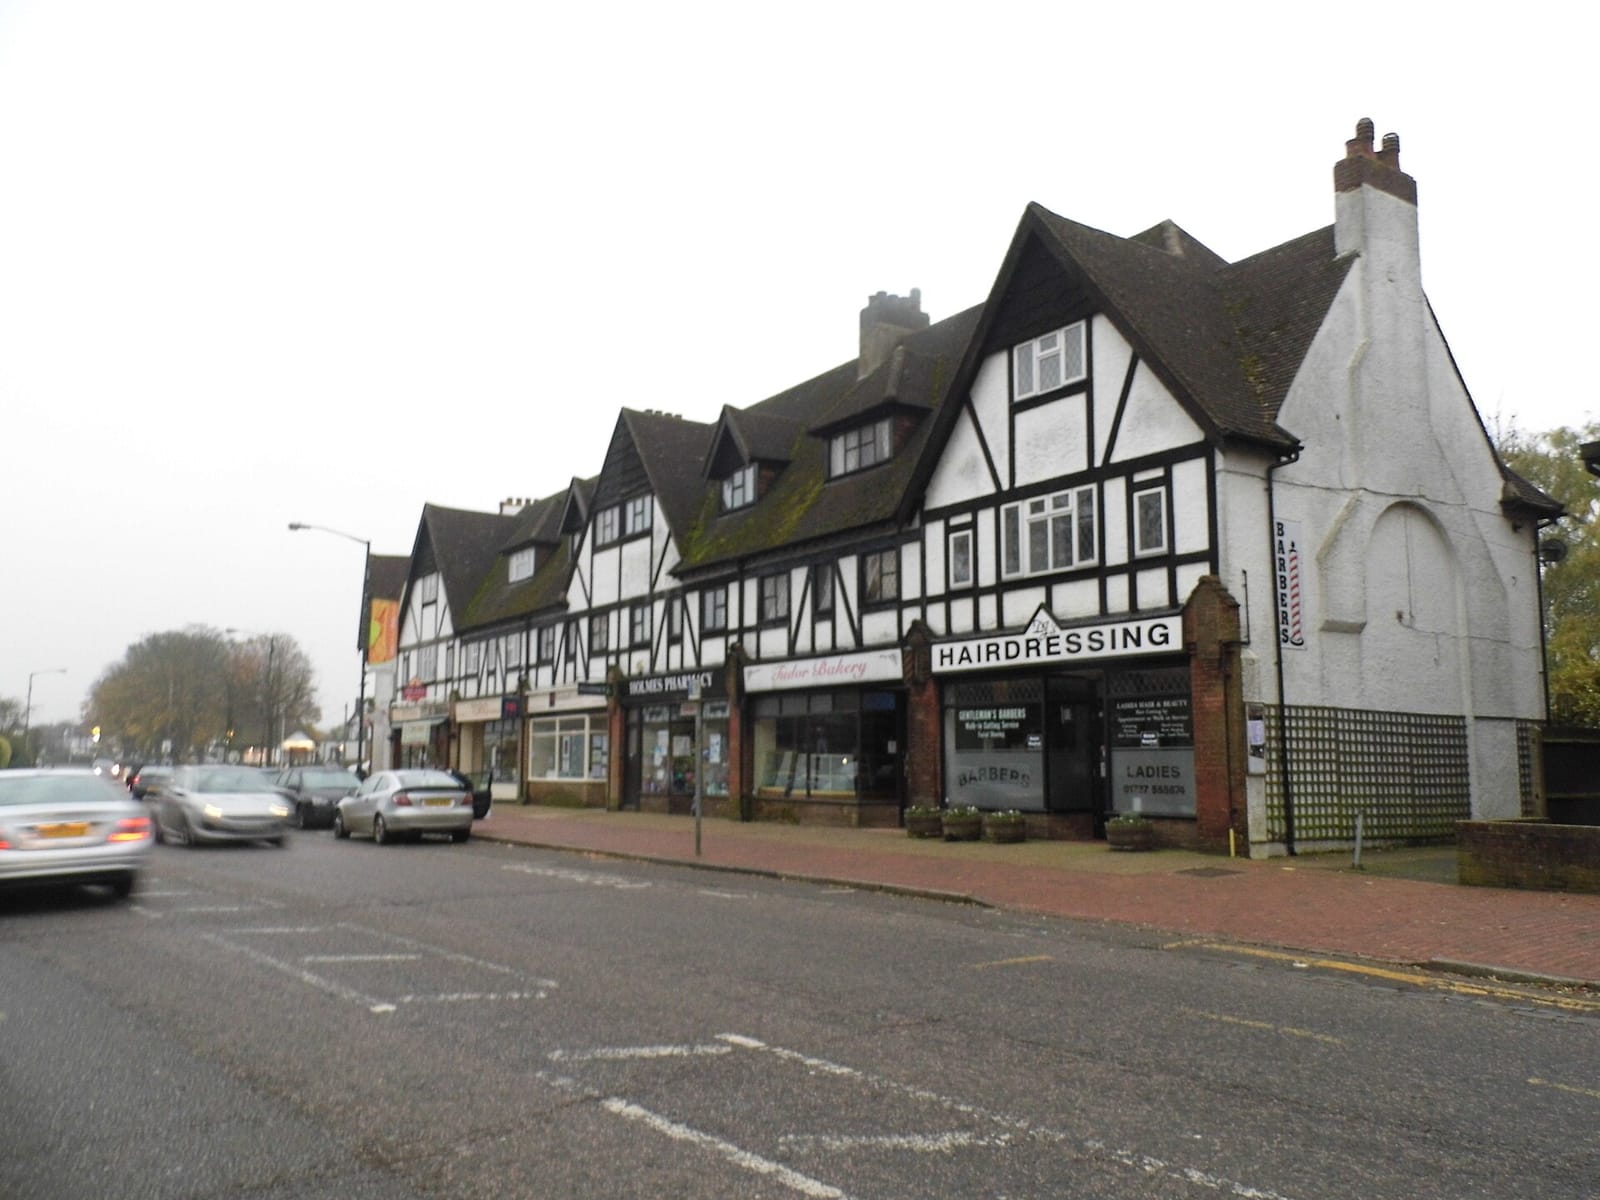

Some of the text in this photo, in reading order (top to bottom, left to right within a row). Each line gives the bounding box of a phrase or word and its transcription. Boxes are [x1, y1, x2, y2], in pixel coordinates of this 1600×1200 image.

[1276, 521, 1290, 643] BARBERS
[939, 623, 1170, 667] HAIRDRESSING
[772, 656, 867, 681] Tudor Bakery
[629, 678, 663, 695] HOLMES
[959, 708, 1026, 721] GENTLEMAN'S BARBERS
[959, 766, 1031, 789] BARBERS
[1126, 765, 1181, 778] LADIES
